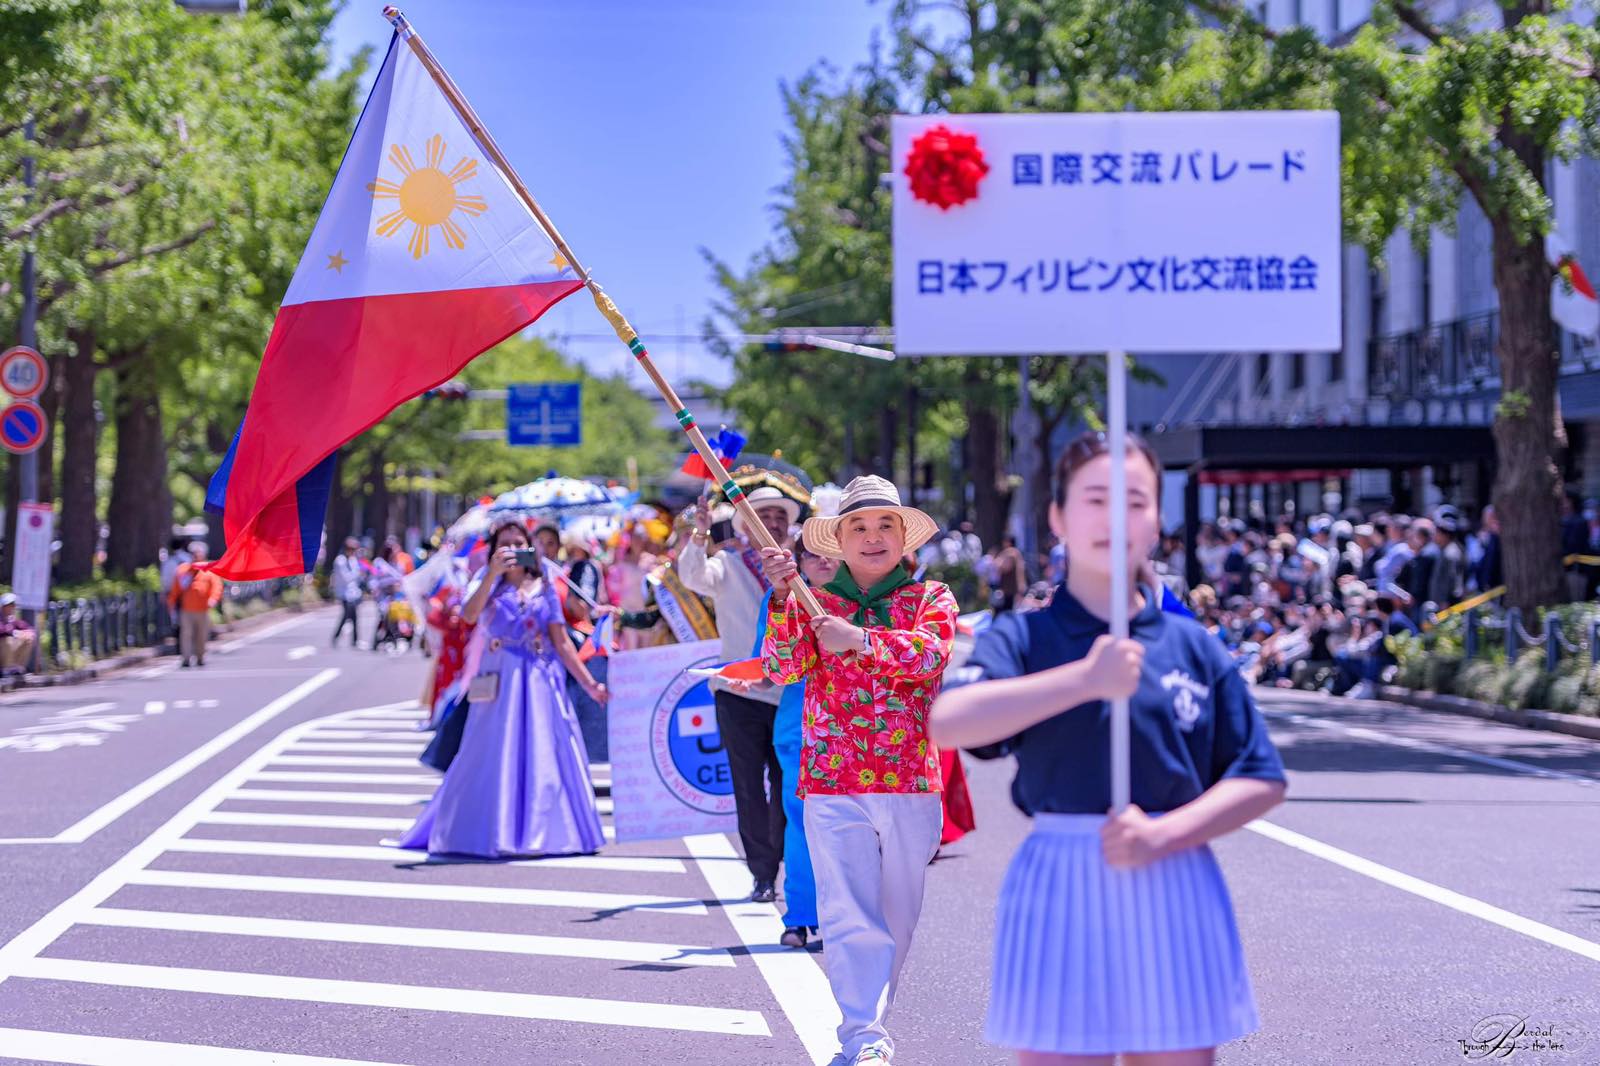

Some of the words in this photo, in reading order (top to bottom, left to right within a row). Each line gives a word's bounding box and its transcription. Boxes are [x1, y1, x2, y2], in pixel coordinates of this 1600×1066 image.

[1012, 150, 1306, 187] 国際交流パレード
[917, 254, 1319, 295] 日本フィリピン文化交流協会
[8, 362, 37, 385] 40
